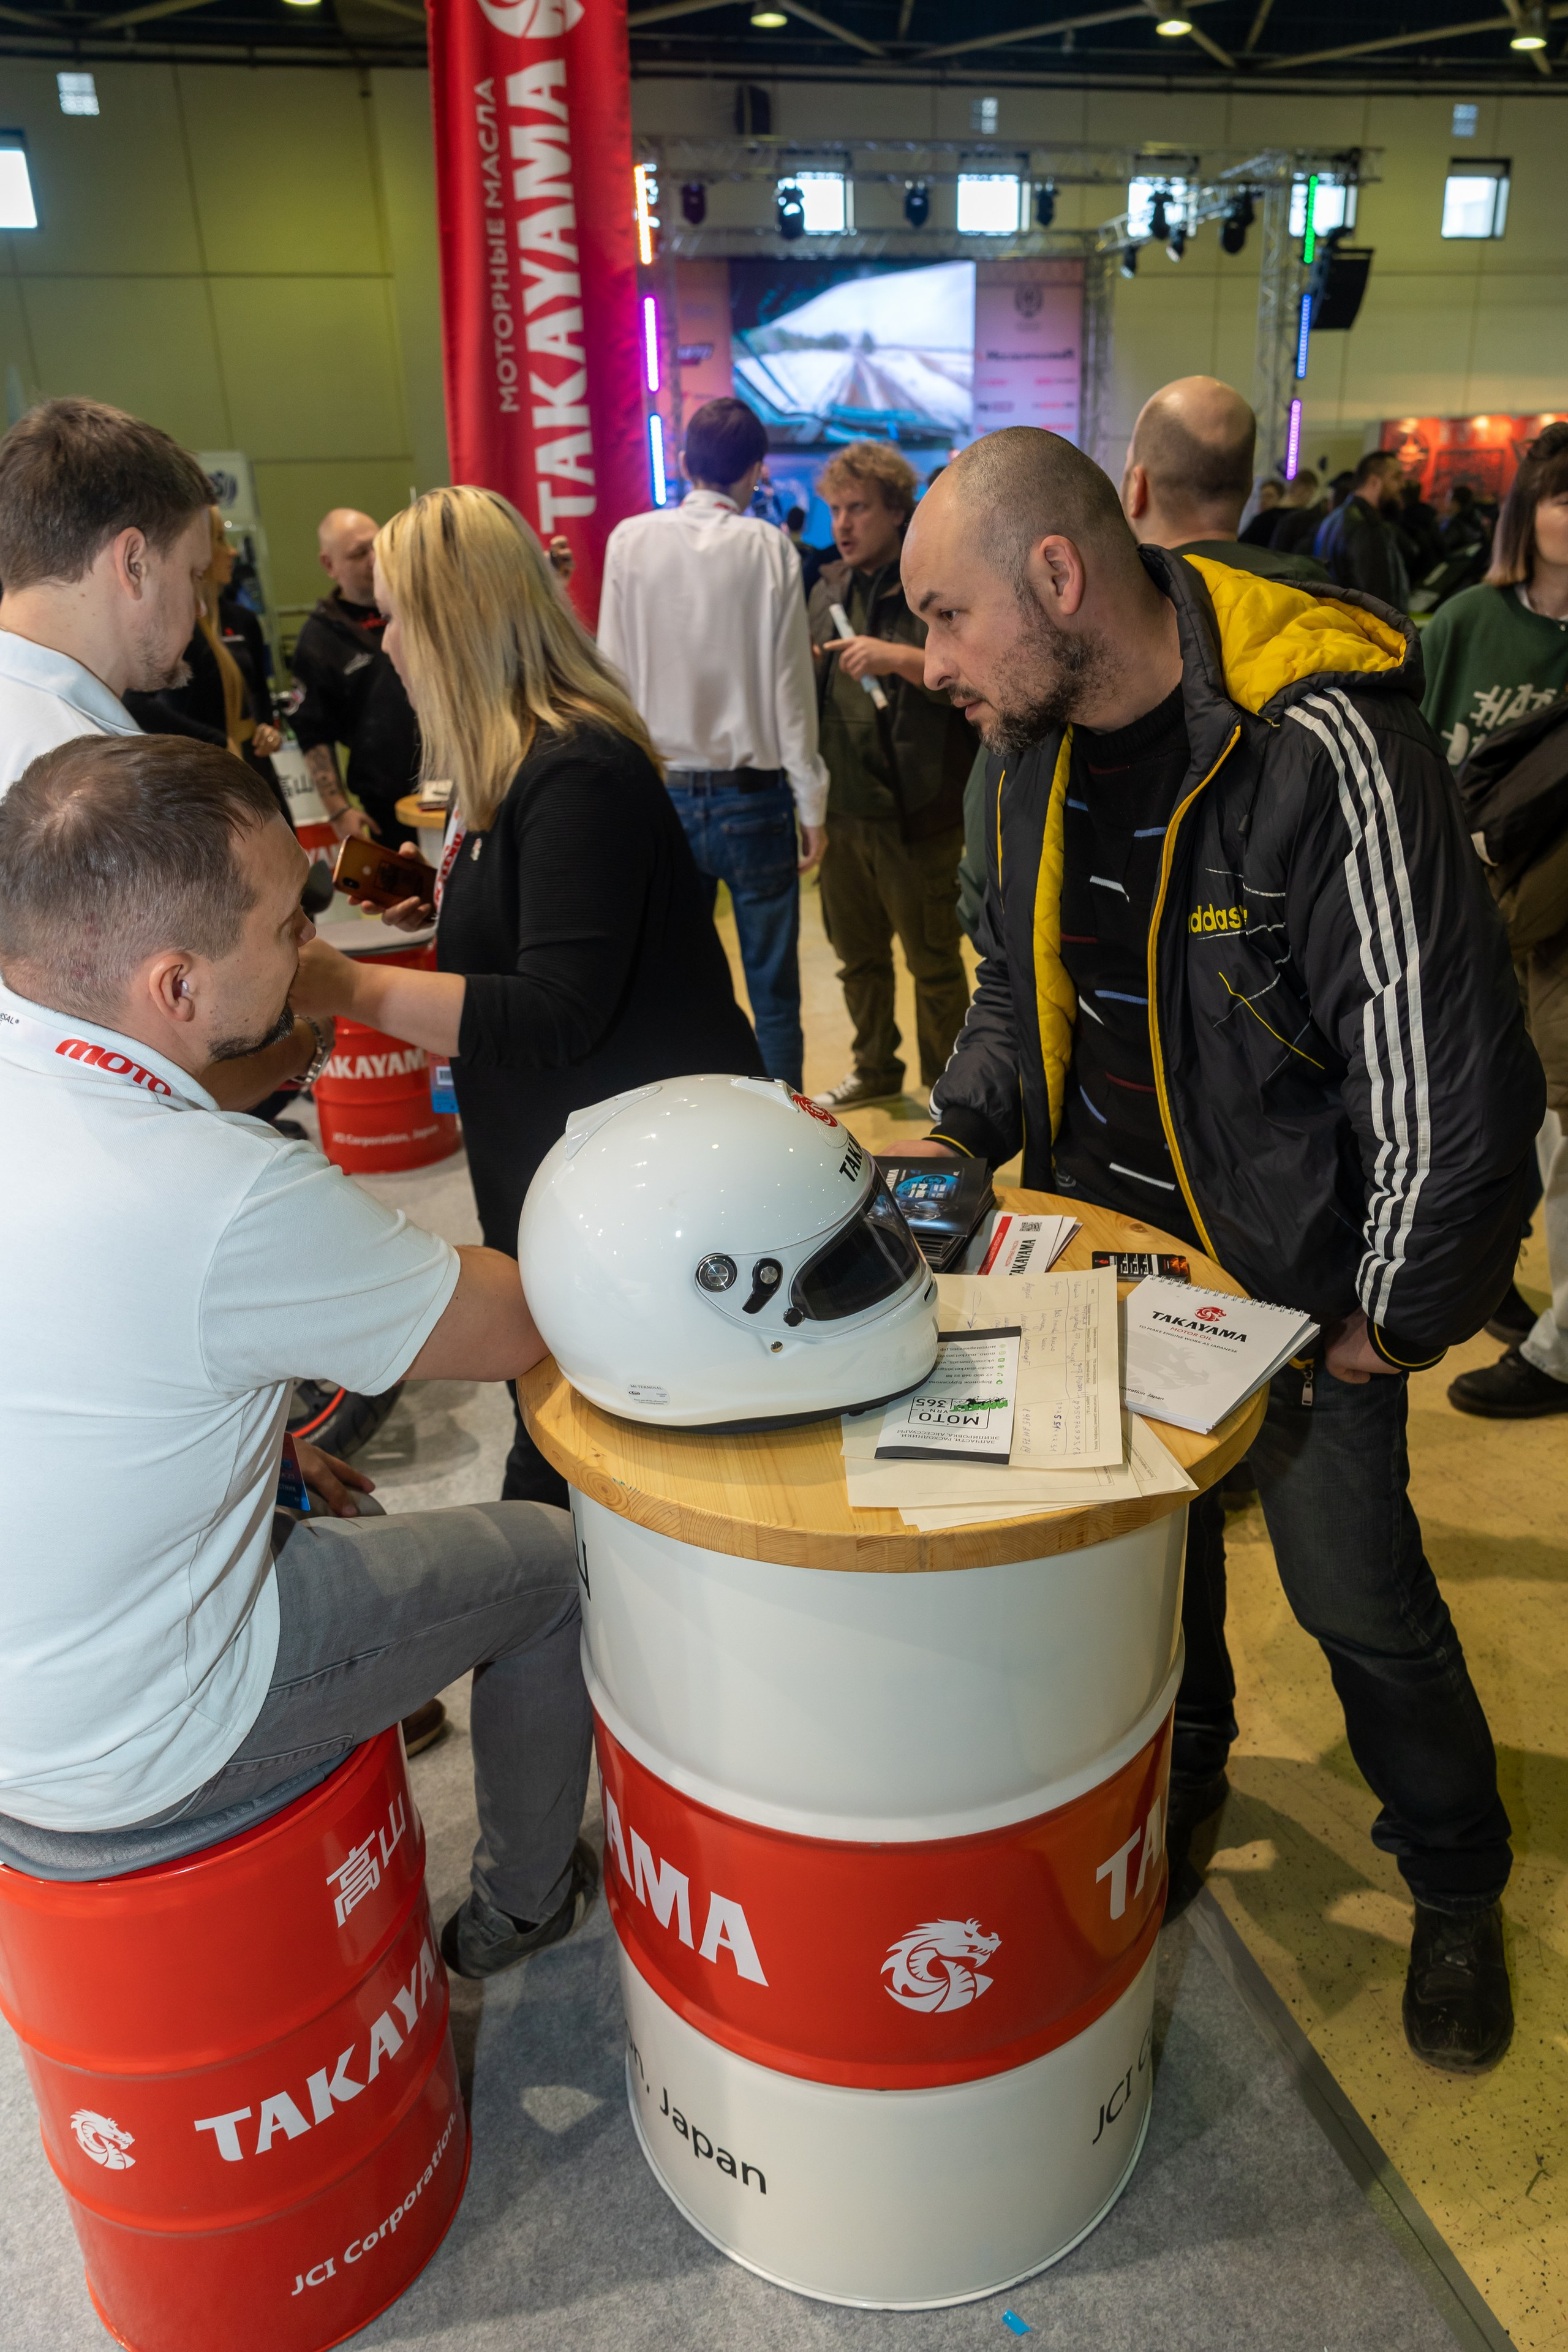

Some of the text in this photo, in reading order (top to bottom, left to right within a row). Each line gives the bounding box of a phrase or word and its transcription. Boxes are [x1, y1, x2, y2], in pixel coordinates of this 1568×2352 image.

[473, 78, 520, 413] МОТОРНЫЕ МАСЛА
[505, 58, 597, 535] TAKAYAMA
[55, 1038, 172, 1097] MOTO
[1153, 1311, 1247, 1343] TAKAYAMA
[1163, 1331, 1184, 1340] ENGINE
[1210, 1344, 1238, 1354] JAPANESE
[1170, 1327, 1199, 1337] MOTOR
[916, 1399, 947, 1408] 365
[919, 1412, 980, 1425] MOTO
[949, 1400, 1008, 1412] MARKET
[326, 1790, 406, 1928] 高山
[604, 1784, 769, 1987] AMA
[1092, 2064, 1133, 2145] JCI
[659, 2086, 767, 2195] Japan
[291, 2111, 458, 2297] JCI Corporation,
